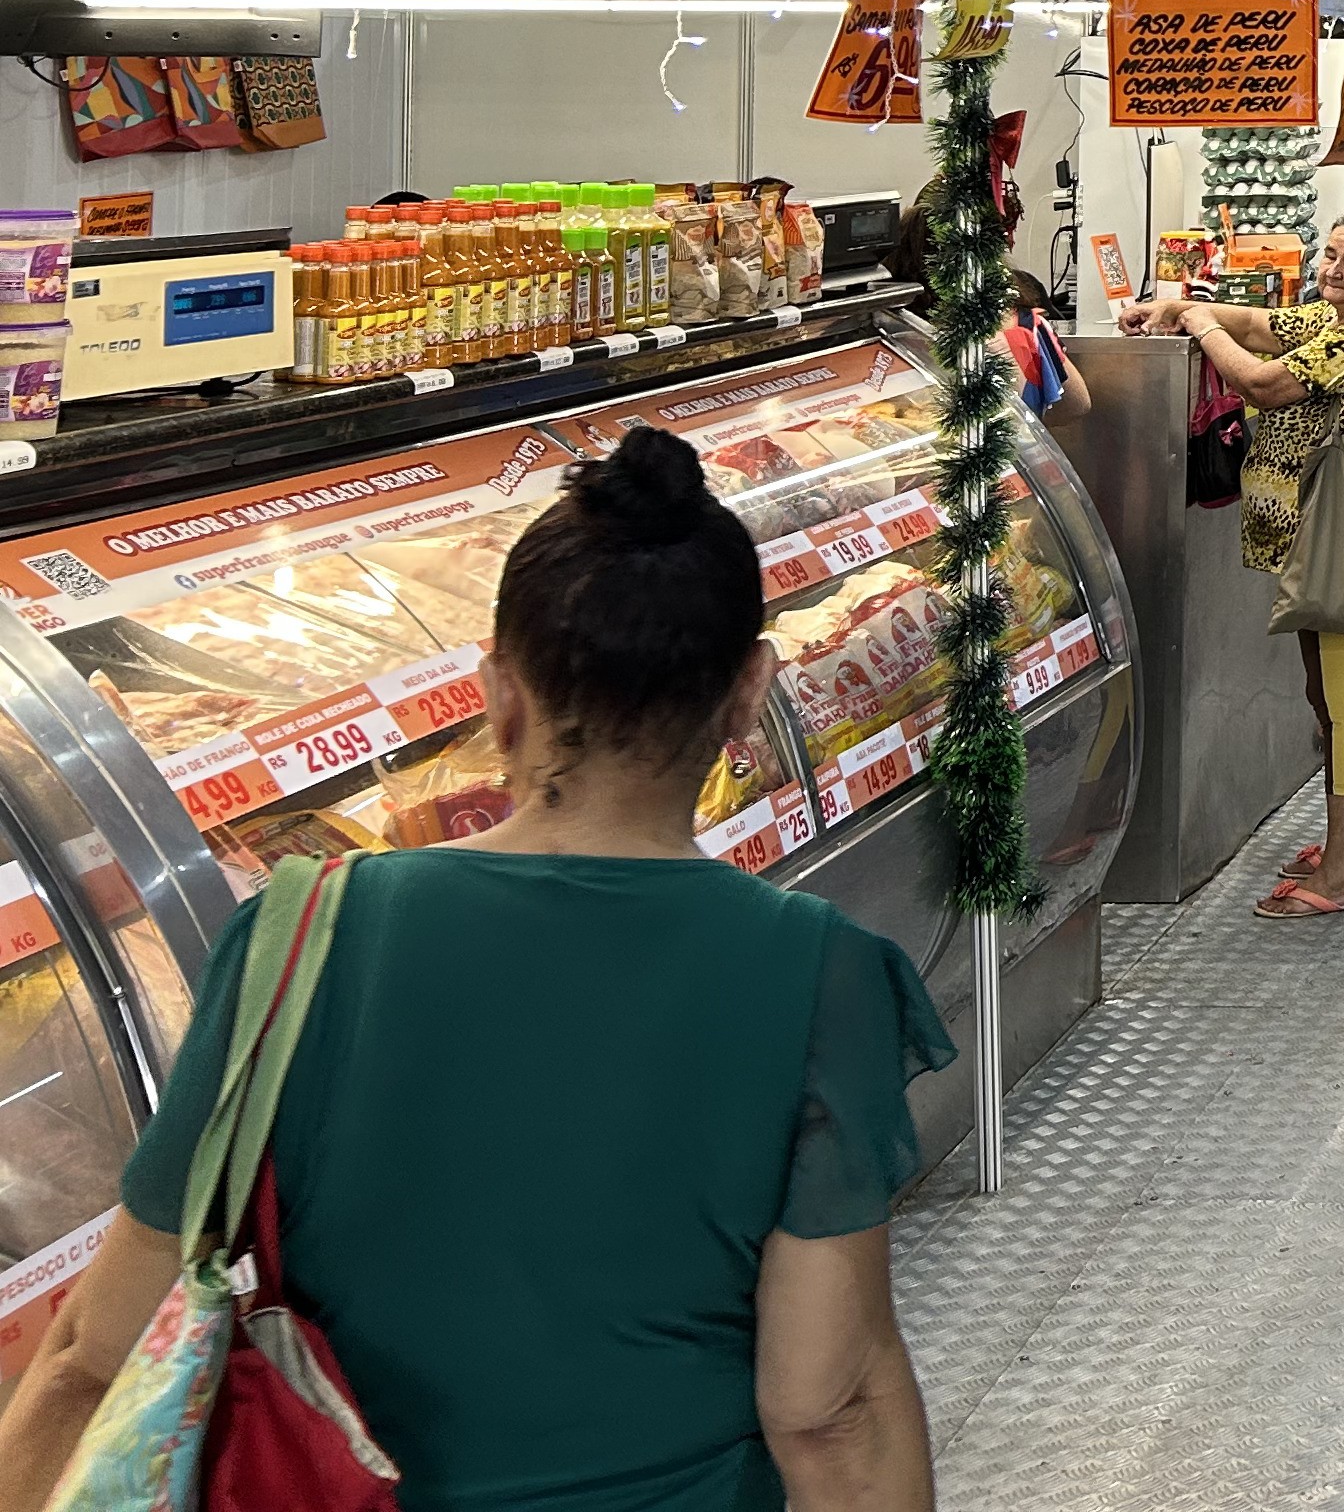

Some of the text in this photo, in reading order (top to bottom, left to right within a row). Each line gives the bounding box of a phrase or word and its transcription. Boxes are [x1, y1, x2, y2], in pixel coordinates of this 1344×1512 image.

[1128, 10, 1297, 36] ASA DE PERU
[1128, 34, 1287, 56] COXA DE PERU
[1217, 56, 1245, 73] DE
[1244, 54, 1306, 72] PERU
[1217, 76, 1239, 91] DE
[1238, 75, 1297, 93] PERU
[1209, 98, 1234, 114] DE
[1233, 95, 1293, 114] PERU
[79, 338, 141, 355] TOLEDO
[490, 437, 547, 497] Desde 1973
[107, 463, 446, 556] O MELHOR E MAIS BARATO SEMPRE
[893, 514, 931, 542] 24,99
[832, 534, 875, 565] 19,99
[769, 558, 809, 590] 15,99
[418, 679, 486, 729] 23,99
[187, 740, 251, 772] DE FRANGO
[267, 722, 402, 775] R$ 28,99 KG
[862, 754, 898, 796] 14,99
[256, 780, 277, 798] KG
[726, 820, 747, 839] GALO
[10, 930, 37, 953] KG
